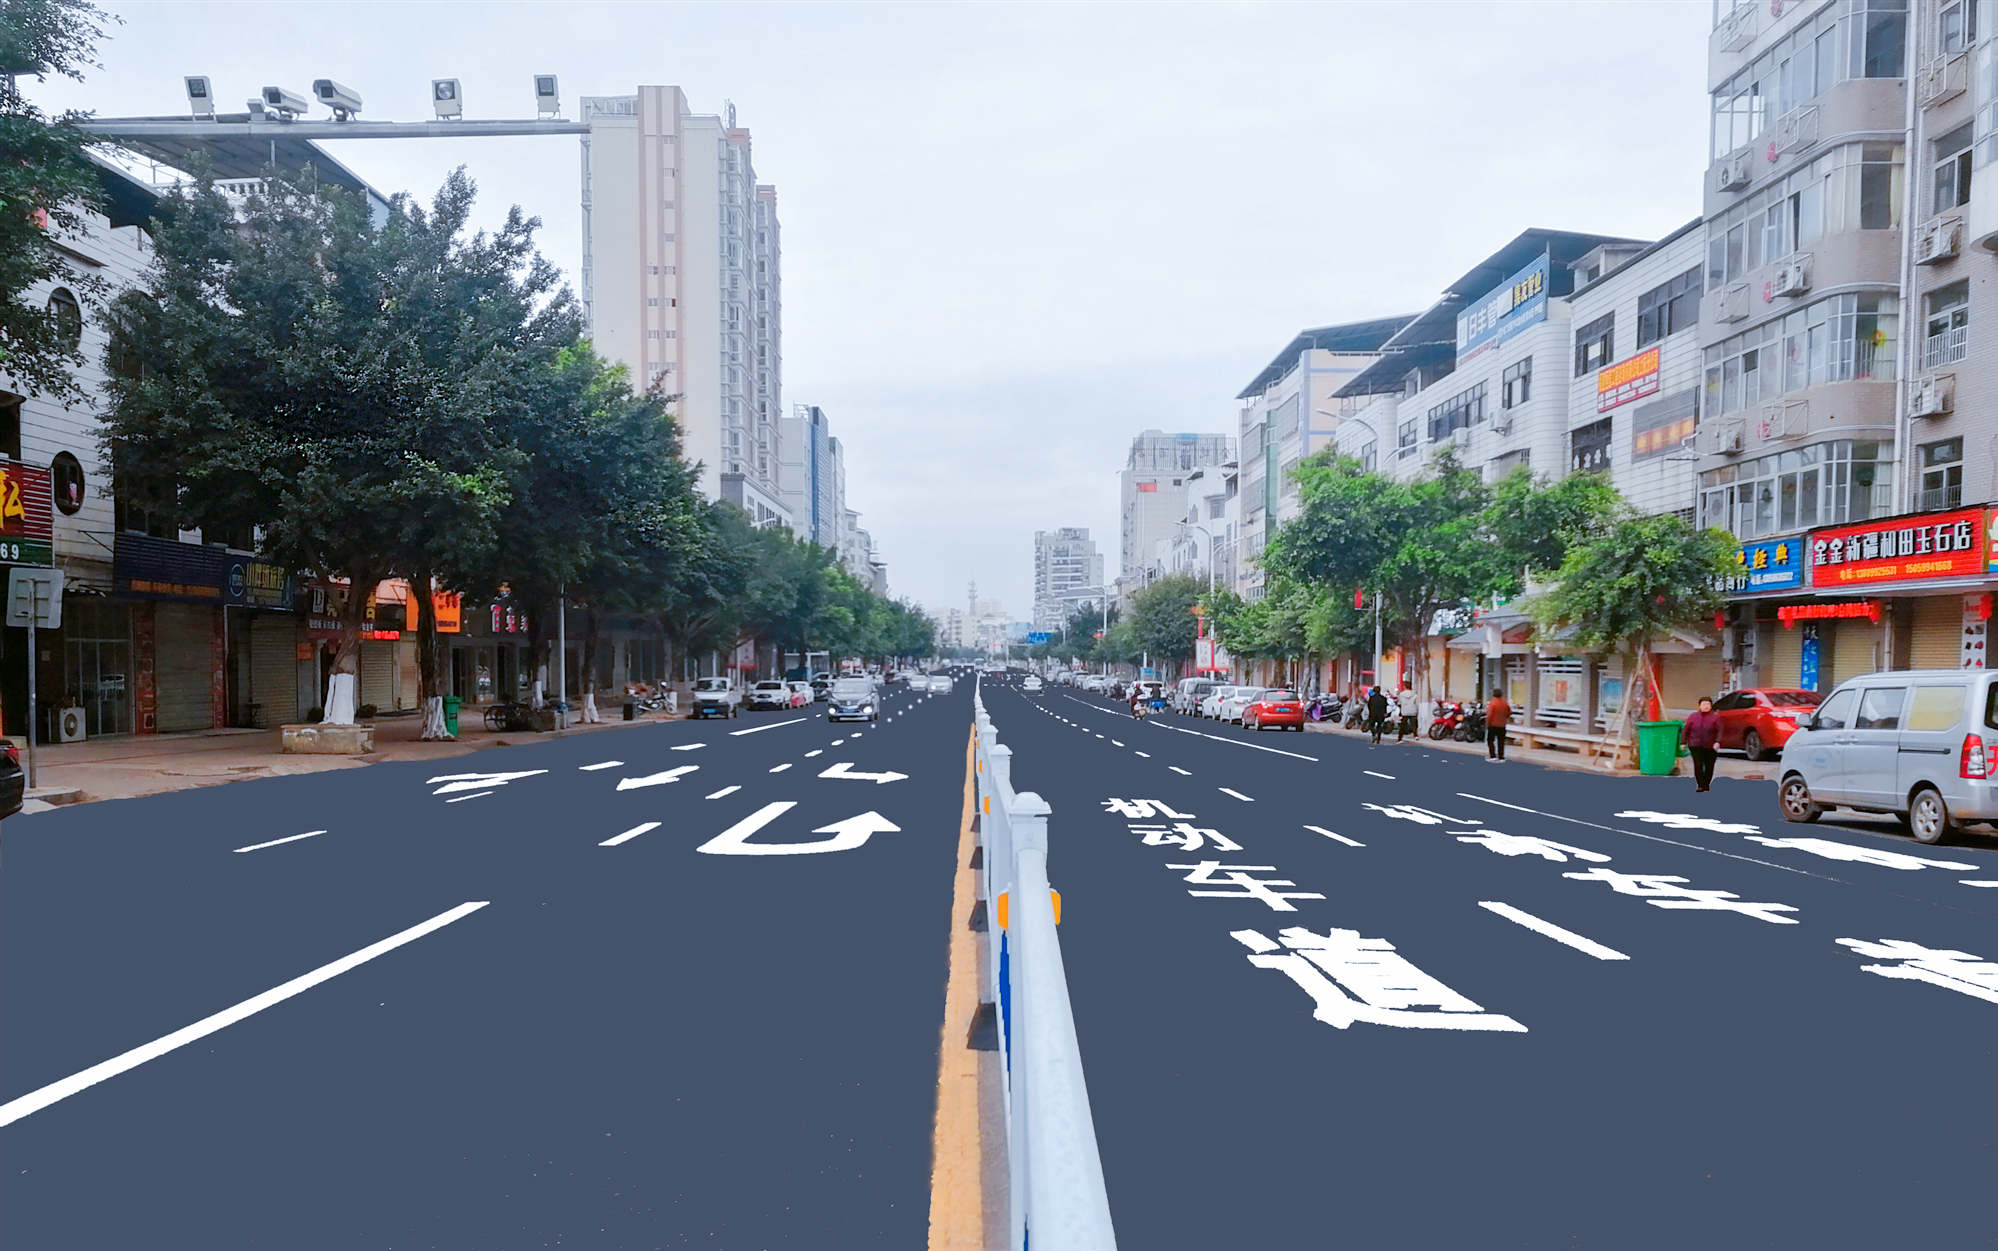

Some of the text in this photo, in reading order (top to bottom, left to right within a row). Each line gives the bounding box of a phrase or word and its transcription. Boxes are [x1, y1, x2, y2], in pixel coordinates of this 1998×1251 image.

[0, 543, 20, 560] 69
[1814, 520, 1972, 566] 金金新疆和田玉石店
[1102, 799, 1529, 1032] 机动车道
